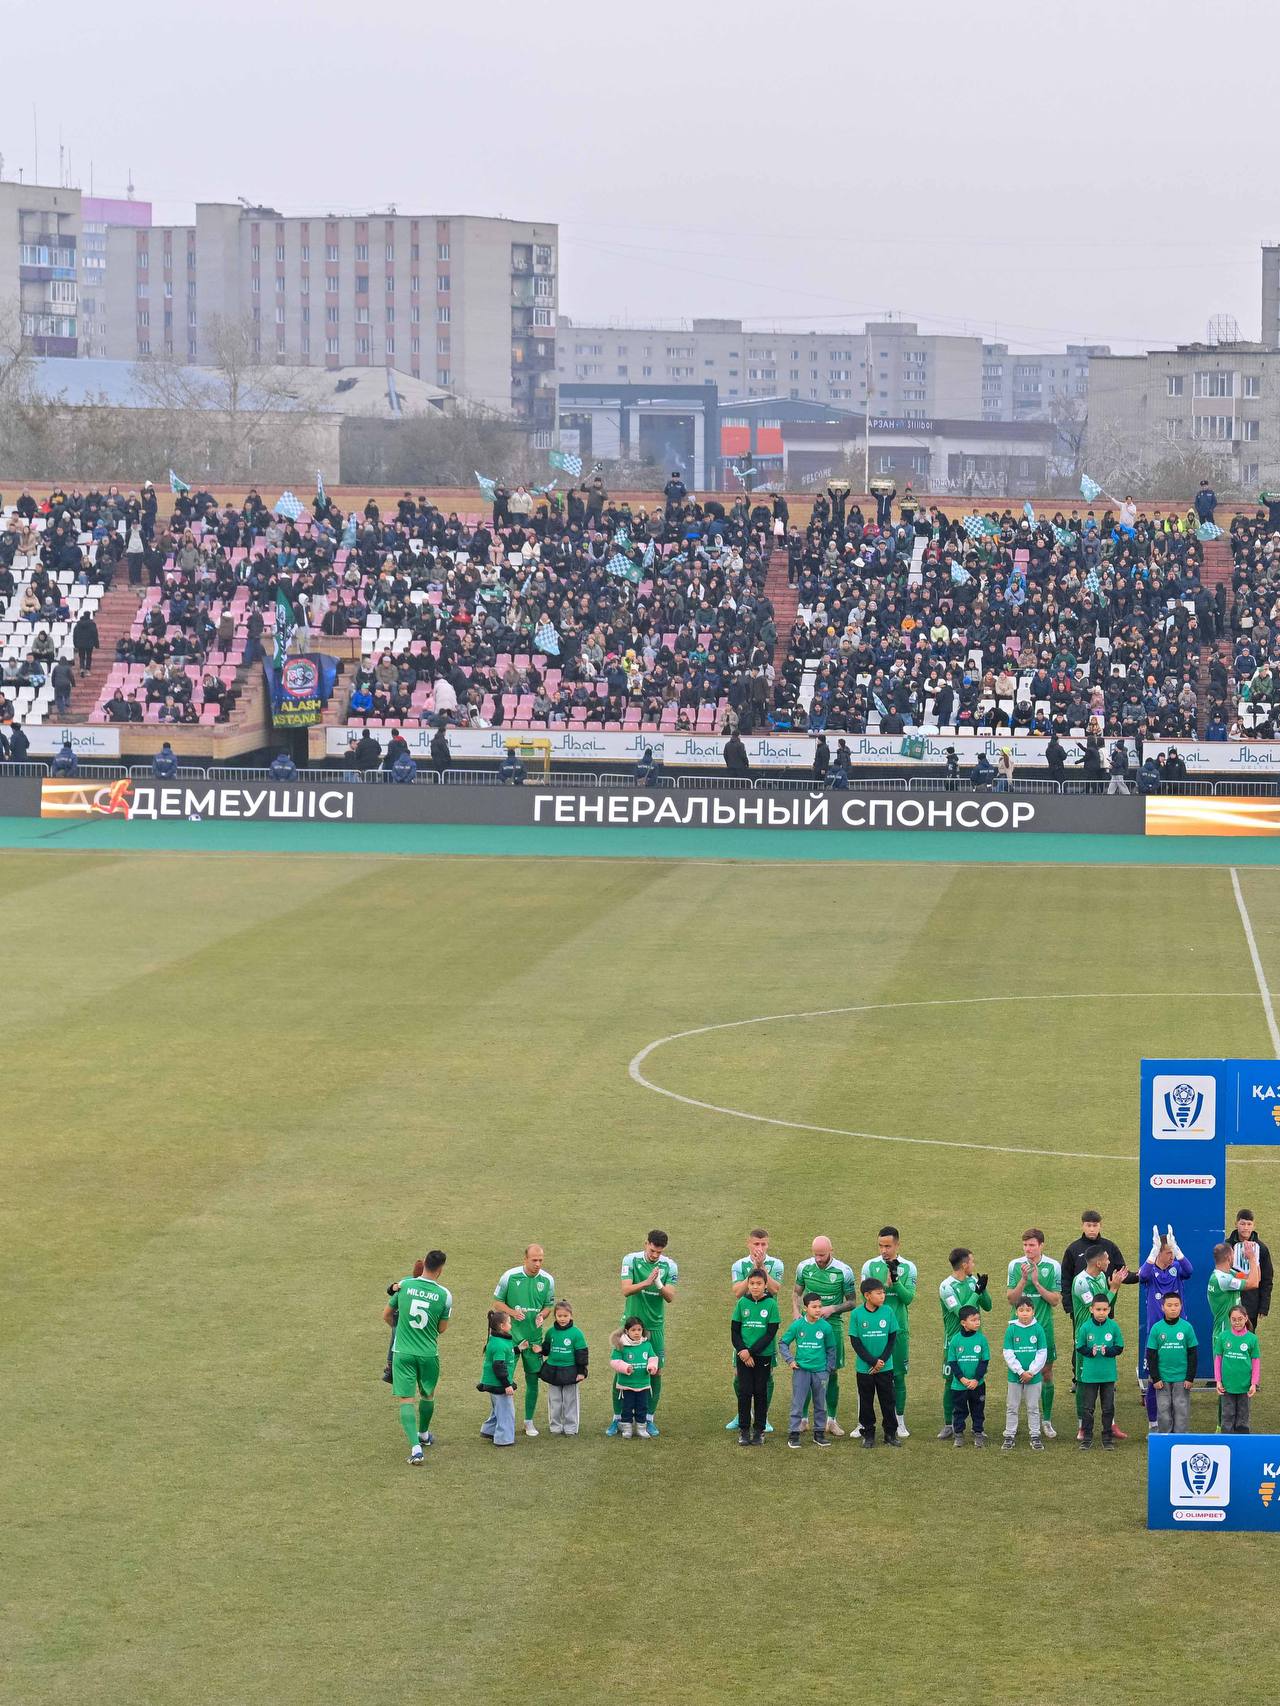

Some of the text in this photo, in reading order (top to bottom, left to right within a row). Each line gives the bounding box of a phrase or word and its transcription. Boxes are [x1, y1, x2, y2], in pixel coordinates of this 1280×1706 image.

[281, 700, 322, 712] ALASH
[556, 733, 604, 751] Abai
[678, 738, 723, 757] Abai
[751, 739, 799, 758] Abai
[852, 738, 899, 757] Abai
[1233, 746, 1279, 764] Abai
[128, 787, 354, 820] ДЕМЕУШІСІ
[534, 792, 1035, 829] ГЕНЕРАЛЬНЫЙ СПОНСОР
[407, 1288, 439, 1301] MILOJKO
[409, 1299, 430, 1330] 5
